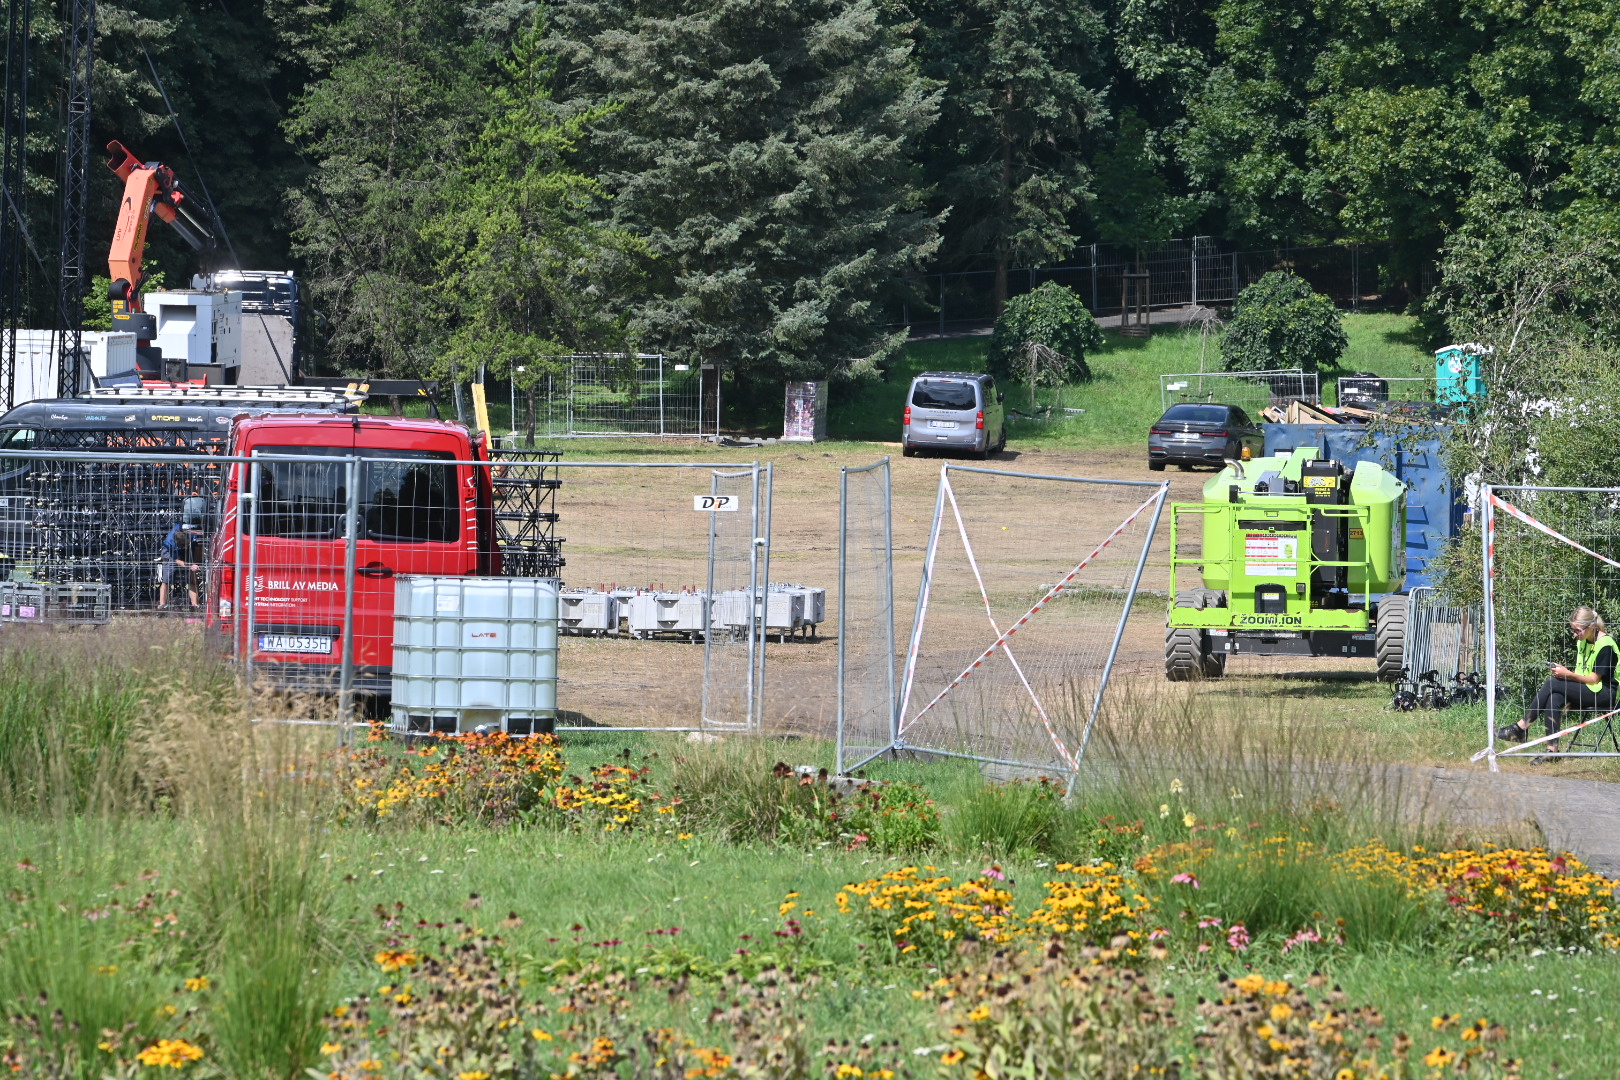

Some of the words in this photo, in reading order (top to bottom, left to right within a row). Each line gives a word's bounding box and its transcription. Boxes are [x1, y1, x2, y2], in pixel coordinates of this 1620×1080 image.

[267, 580, 290, 590] BRILL
[307, 581, 339, 591] MEDIA
[267, 635, 283, 648] WA
[288, 636, 328, 650] 0535H
